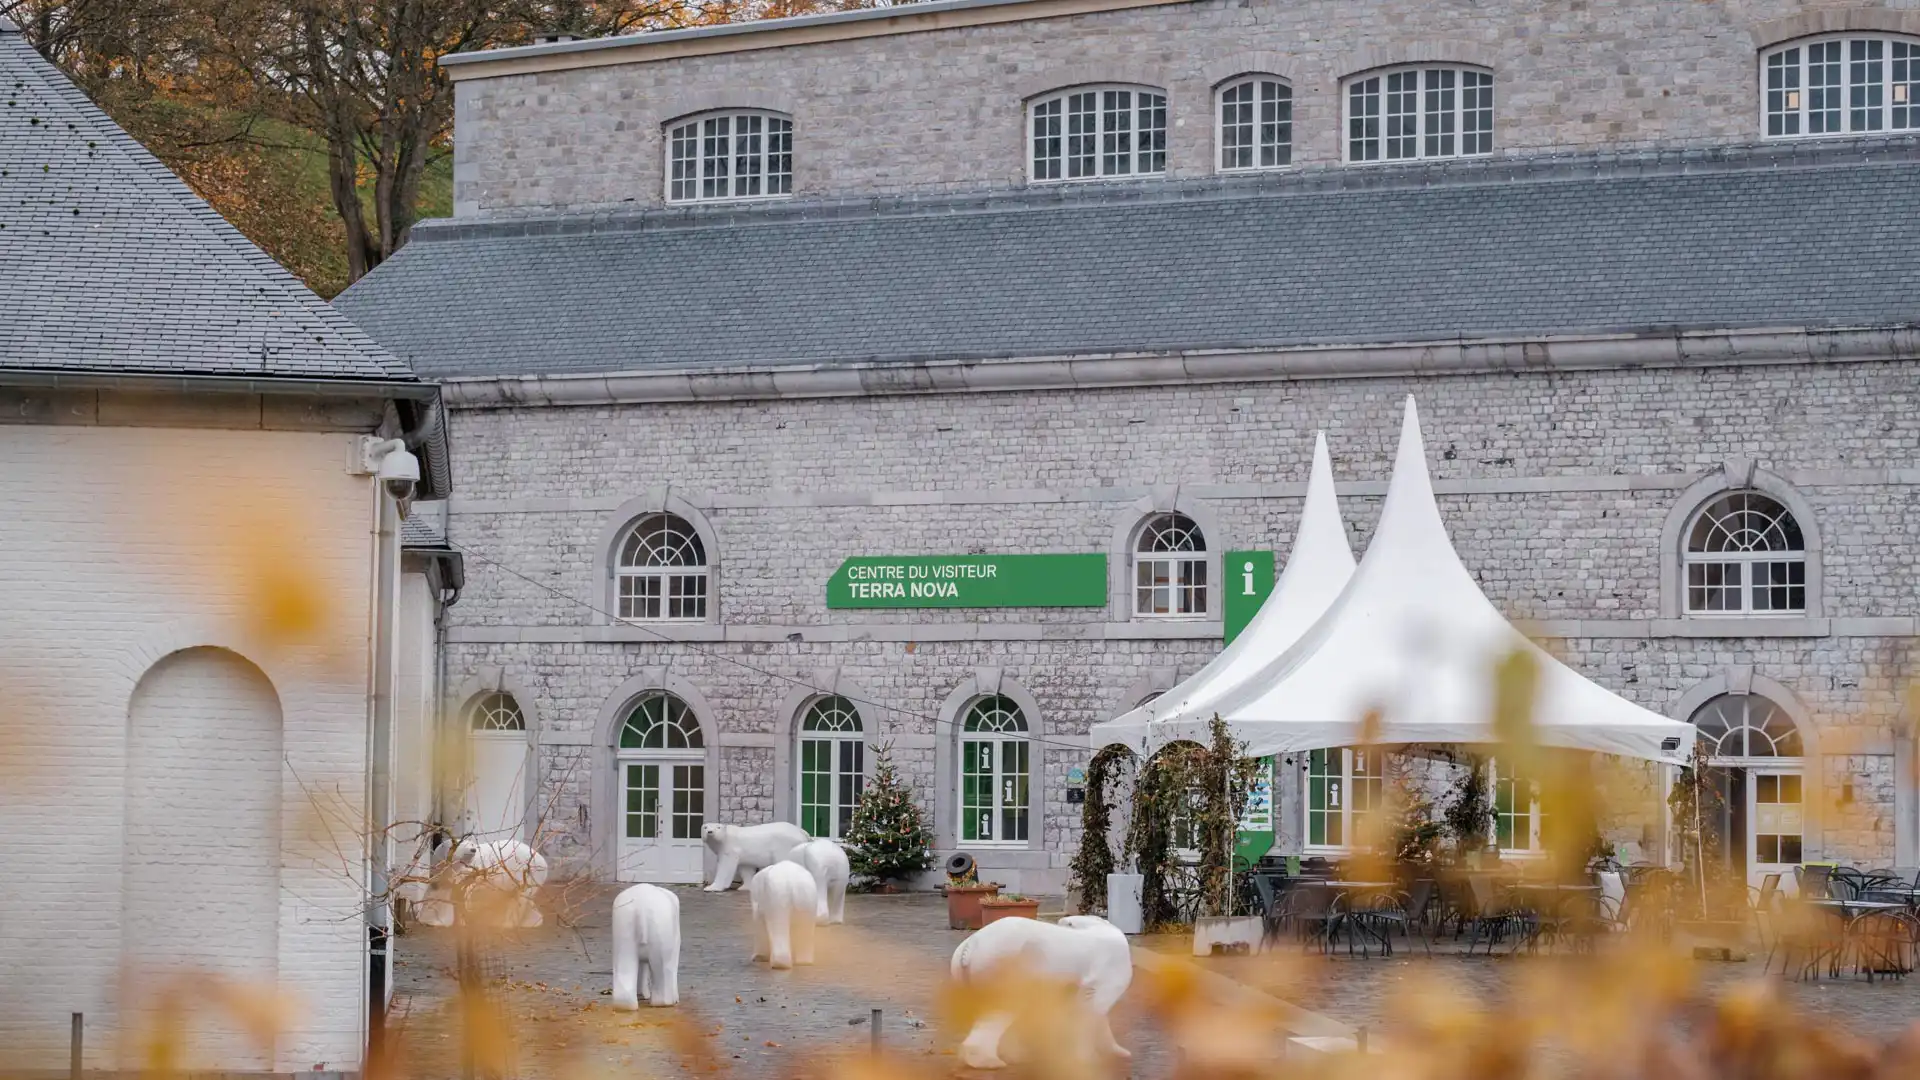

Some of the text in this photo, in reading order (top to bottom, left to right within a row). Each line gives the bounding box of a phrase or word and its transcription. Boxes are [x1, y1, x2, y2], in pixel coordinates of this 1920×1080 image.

[847, 564, 997, 580] CENTRE DU VISITEUR
[1242, 561, 1256, 595] i
[848, 581, 959, 599] TERRA NOVA
